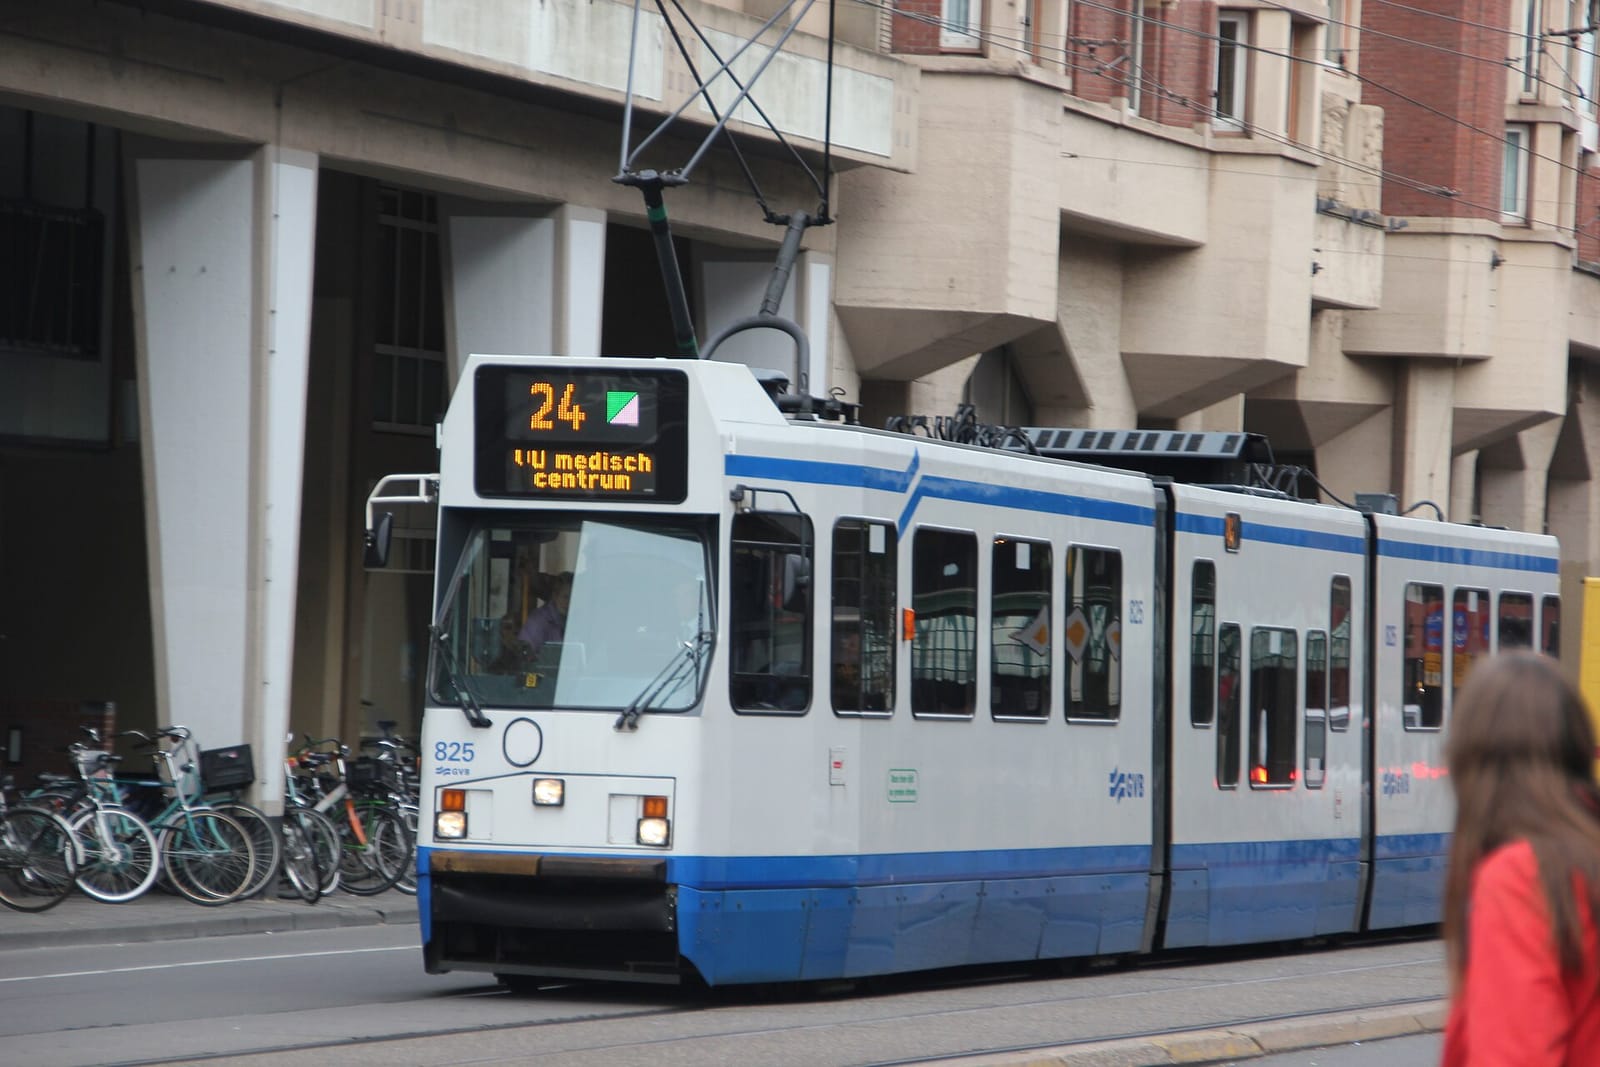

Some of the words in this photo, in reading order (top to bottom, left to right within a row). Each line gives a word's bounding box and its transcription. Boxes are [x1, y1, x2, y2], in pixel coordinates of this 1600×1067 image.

[530, 382, 586, 431] 24
[555, 452, 652, 473] medisch
[533, 470, 630, 491] centrum
[434, 741, 475, 762] 825
[451, 768, 471, 776] GVB
